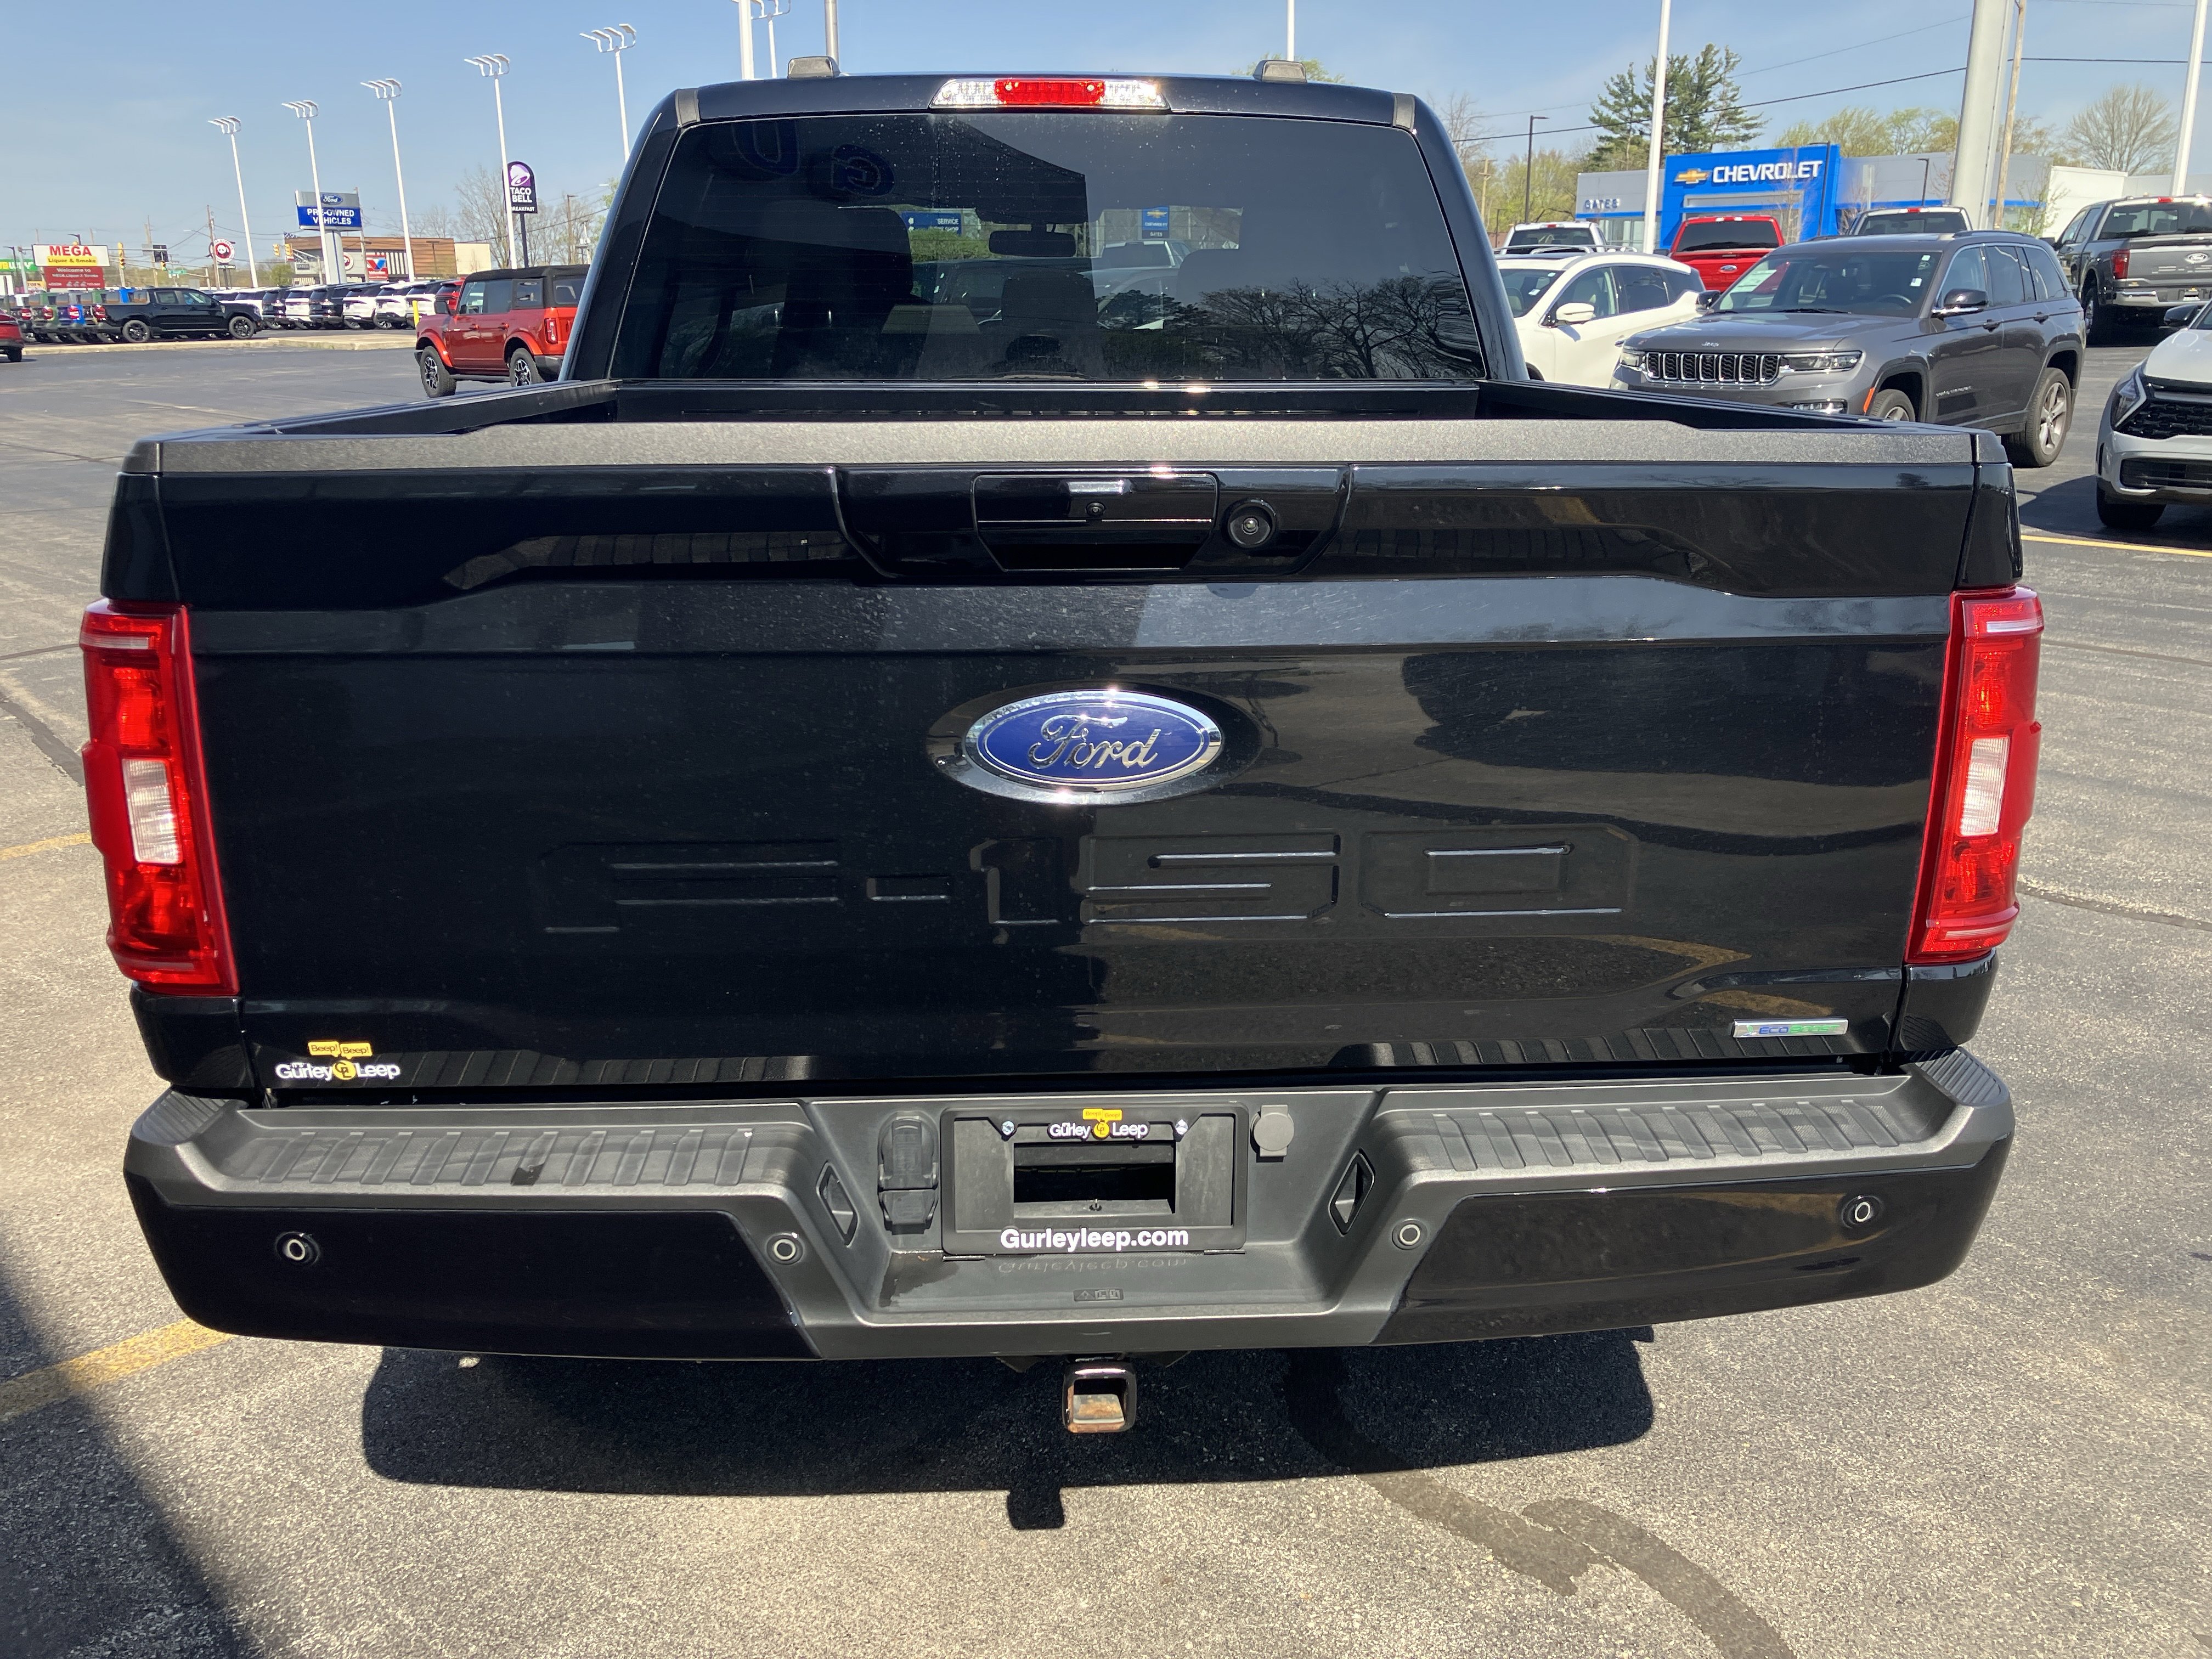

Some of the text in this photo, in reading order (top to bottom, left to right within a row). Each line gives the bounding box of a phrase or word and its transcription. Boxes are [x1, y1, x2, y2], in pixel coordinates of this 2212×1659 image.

[1712, 161, 1822, 183] CHEVROLET
[509, 187, 532, 195] TACO
[512, 195, 533, 203] BELL
[1584, 200, 1620, 209] GATES
[49, 246, 92, 256] MEGA
[1027, 714, 1162, 769] Ford
[311, 1045, 338, 1053] Beep!
[356, 1062, 400, 1079] Leep
[1113, 1122, 1148, 1138] Leep
[1000, 1227, 1189, 1252] Gurleyleep.com
